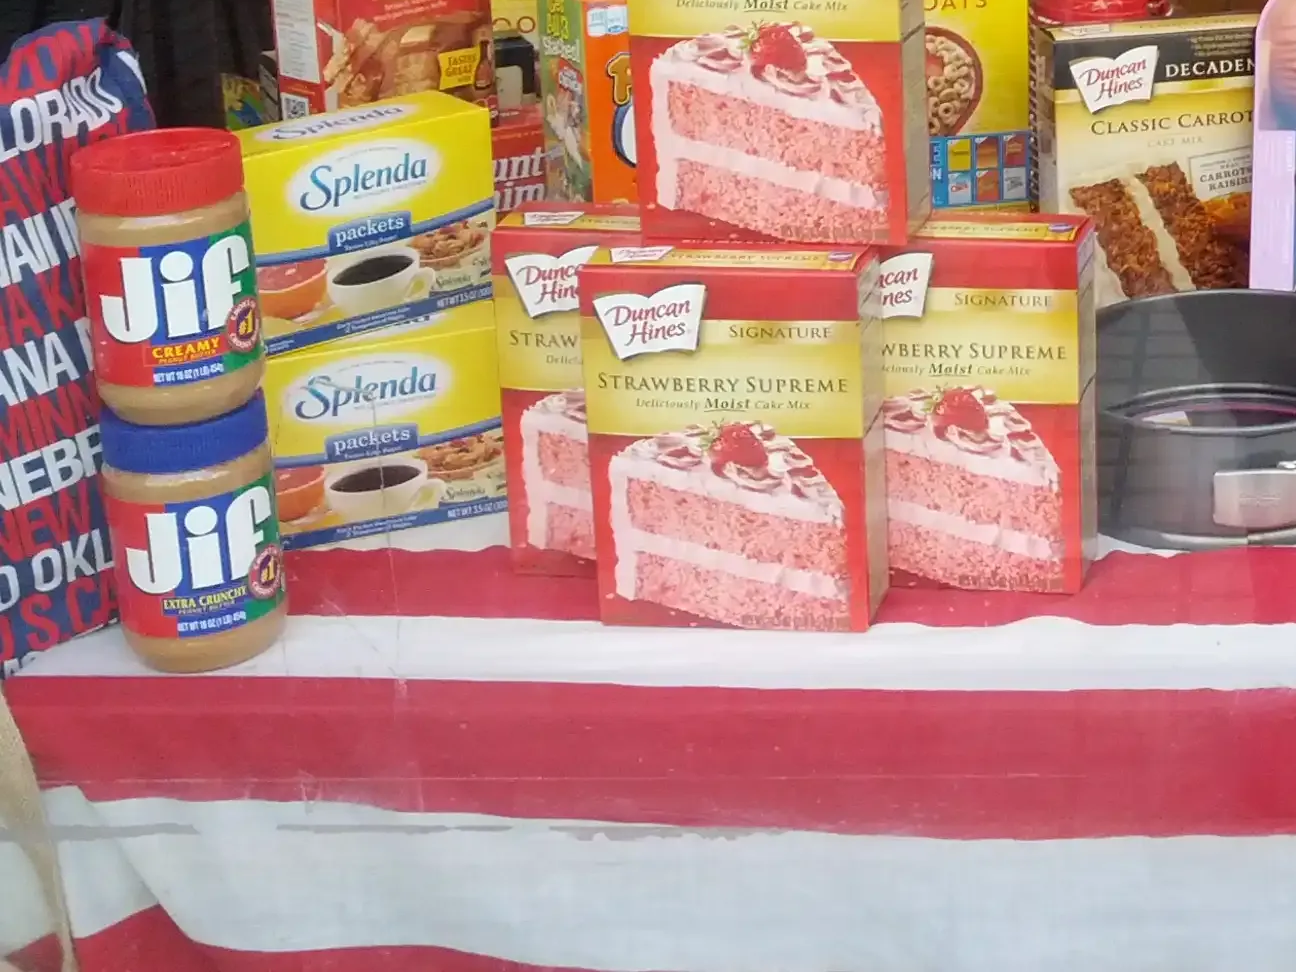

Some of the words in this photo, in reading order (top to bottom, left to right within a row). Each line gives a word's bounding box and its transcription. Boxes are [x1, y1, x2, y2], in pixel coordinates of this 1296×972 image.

[793, 1, 822, 11] Cake
[825, 1, 848, 11] Mix
[1078, 57, 1148, 88] Duncan
[1165, 58, 1254, 78] DECADEN
[1092, 76, 1144, 102] Hines
[1091, 117, 1172, 135] CLASSIC
[1178, 109, 1253, 128] CARROT
[493, 146, 544, 182] unt
[299, 151, 428, 212] Splenda
[1208, 176, 1252, 192] RAISIN
[335, 215, 405, 247] packets
[515, 263, 583, 286] Dunc
[99, 234, 251, 344] Jif
[534, 282, 579, 306] Hin
[882, 288, 914, 306] nes
[954, 291, 1053, 308] SIGNATURE
[604, 297, 691, 328] Duncan
[509, 330, 578, 349] STRAW
[624, 320, 687, 348] Hines
[729, 325, 833, 340] SIGNATURE
[152, 337, 221, 359] CREAMY
[880, 343, 964, 360] WBERRY
[969, 342, 1068, 360] SUPREME
[928, 362, 973, 377] Moist
[294, 365, 437, 420] Splenda
[597, 372, 741, 394] STRAWBERRY
[746, 376, 849, 394] SUPREME
[703, 396, 751, 412] Moist
[754, 400, 783, 410] Cake
[787, 400, 812, 410] Mix
[333, 427, 411, 456] packets
[125, 485, 272, 595] Jif
[31, 527, 115, 593] OKL
[163, 598, 196, 611] EXTRA
[199, 586, 248, 607] CRUNCHY
